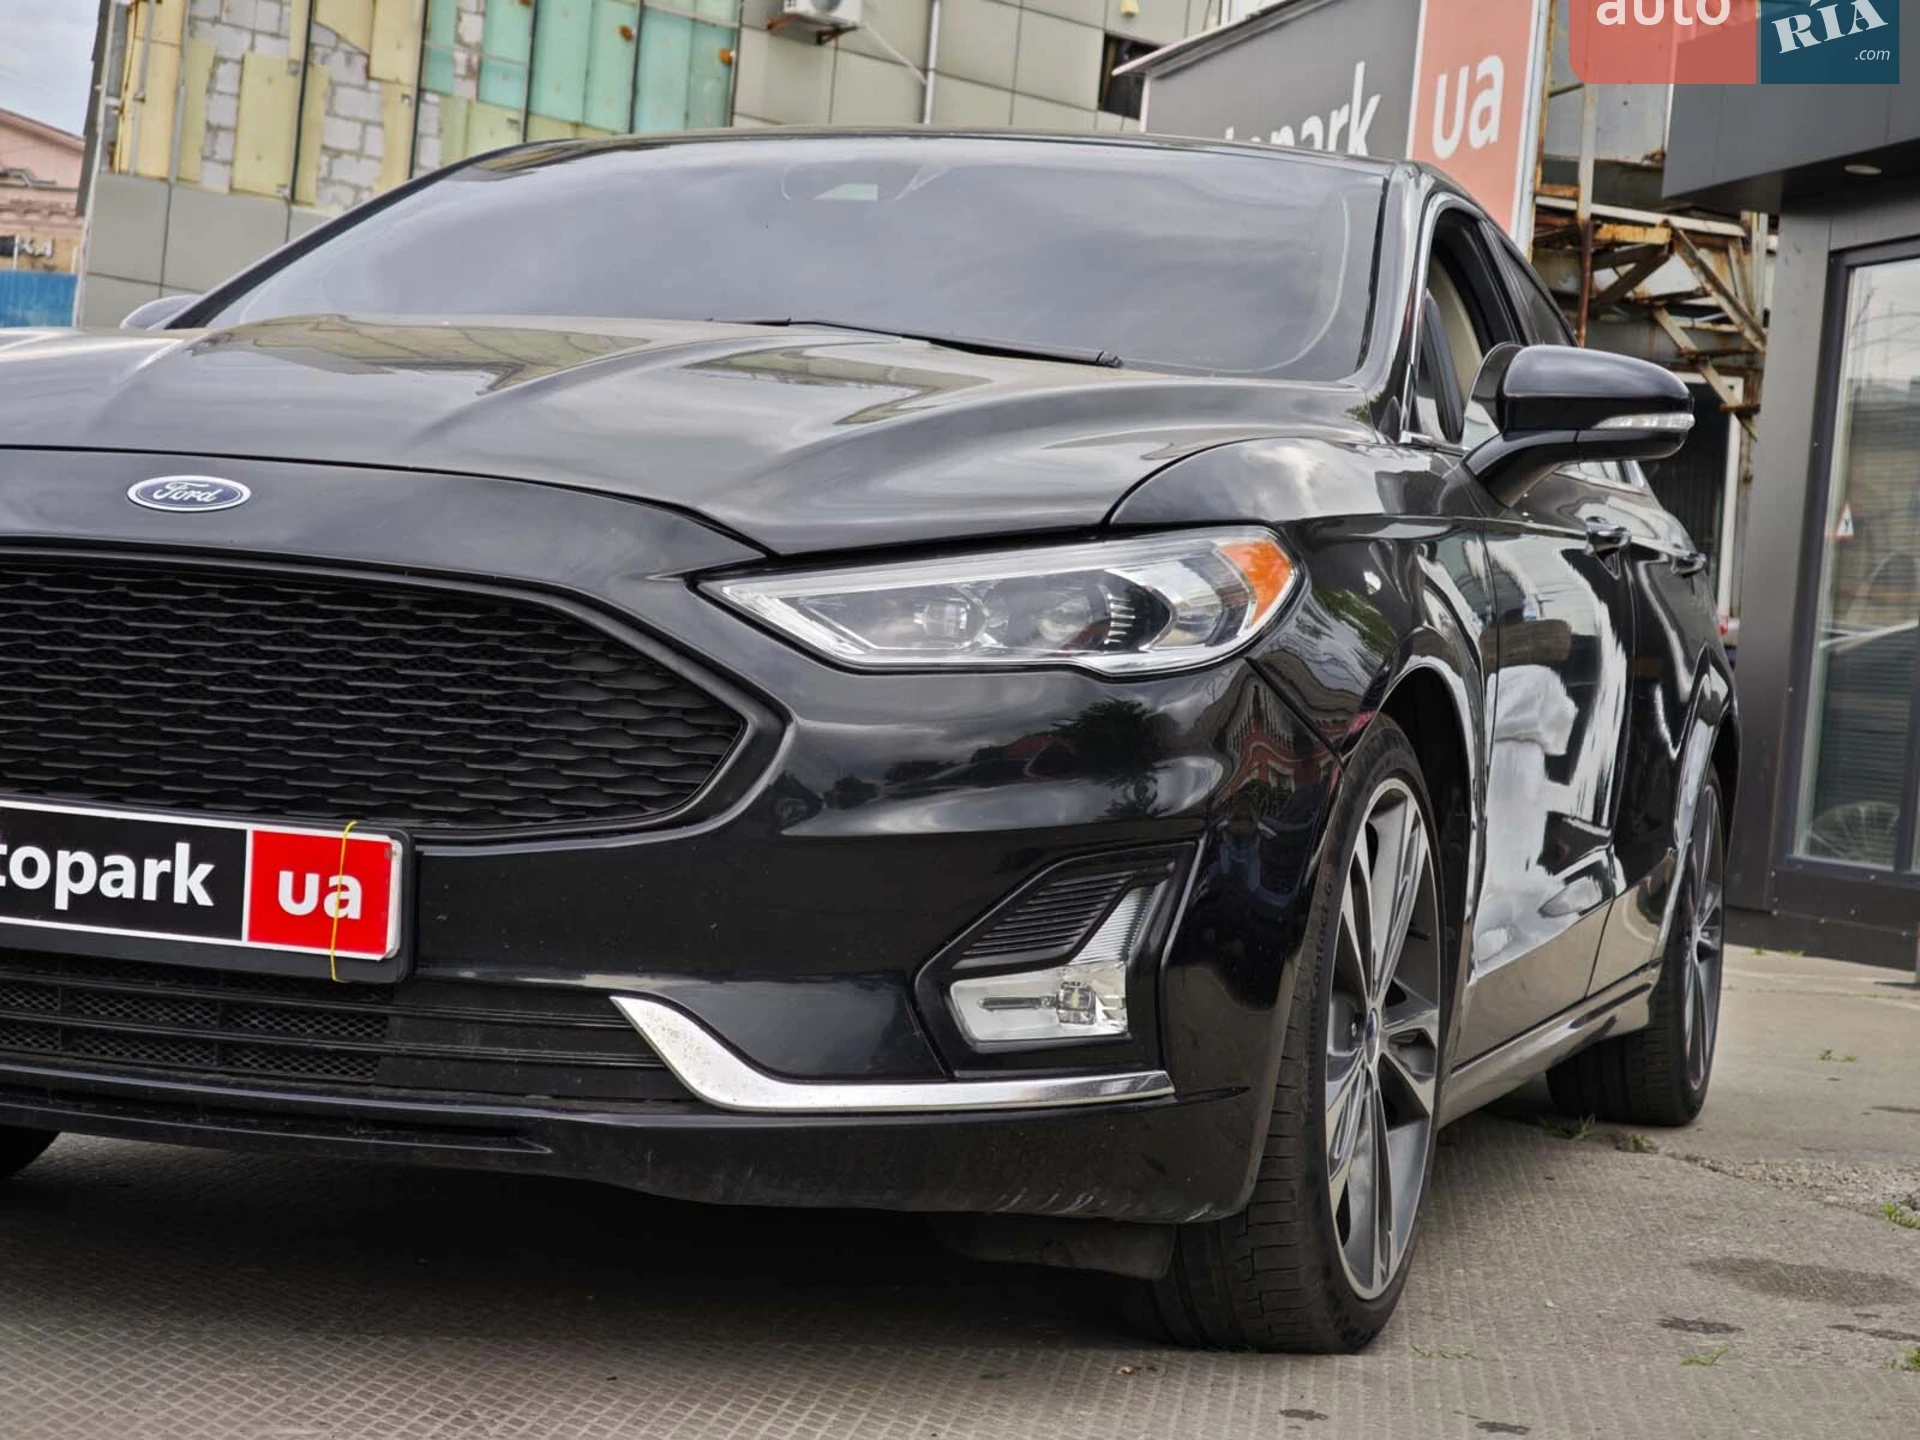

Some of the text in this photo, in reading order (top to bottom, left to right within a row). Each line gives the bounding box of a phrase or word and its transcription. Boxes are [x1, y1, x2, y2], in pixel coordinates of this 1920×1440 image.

[1432, 55, 1505, 160] ua
[152, 481, 224, 502] Ford
[277, 870, 363, 921] ua
